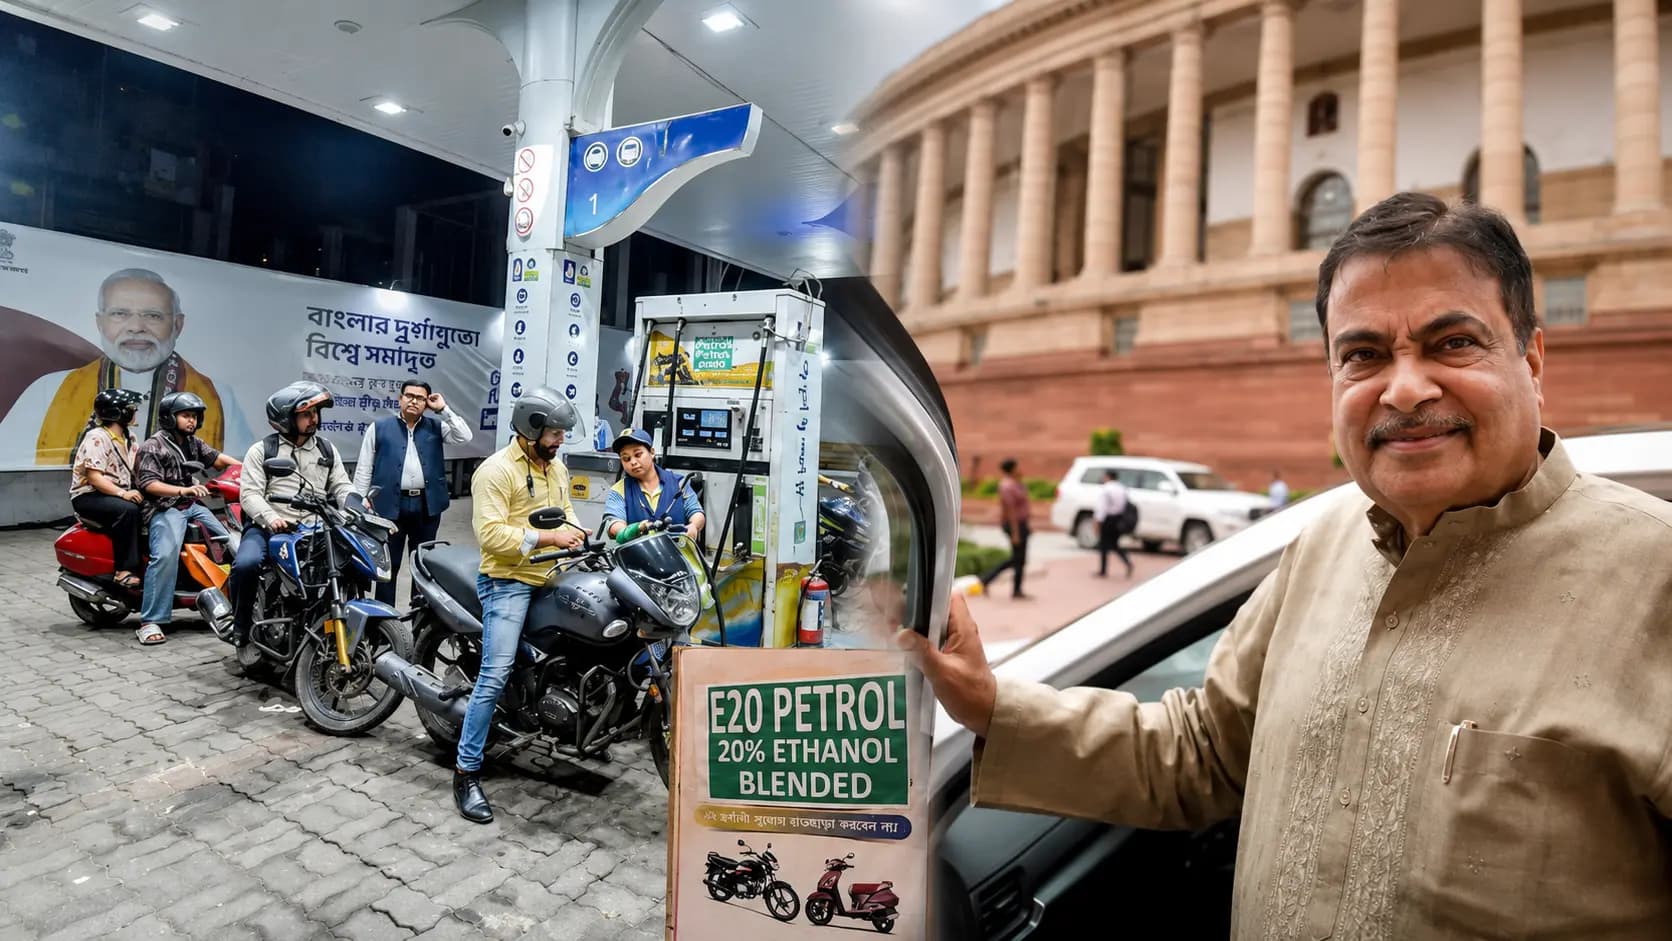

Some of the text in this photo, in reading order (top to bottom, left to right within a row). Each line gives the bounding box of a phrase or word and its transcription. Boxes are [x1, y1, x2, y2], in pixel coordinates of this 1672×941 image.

[588, 193, 598, 215] 1
[306, 306, 390, 334] বাংলার
[306, 333, 361, 366] বিশ্বে
[710, 681, 905, 734] E20 PETROL
[718, 737, 898, 764] 20% ETHANOL
[739, 771, 872, 799] BLENDED
